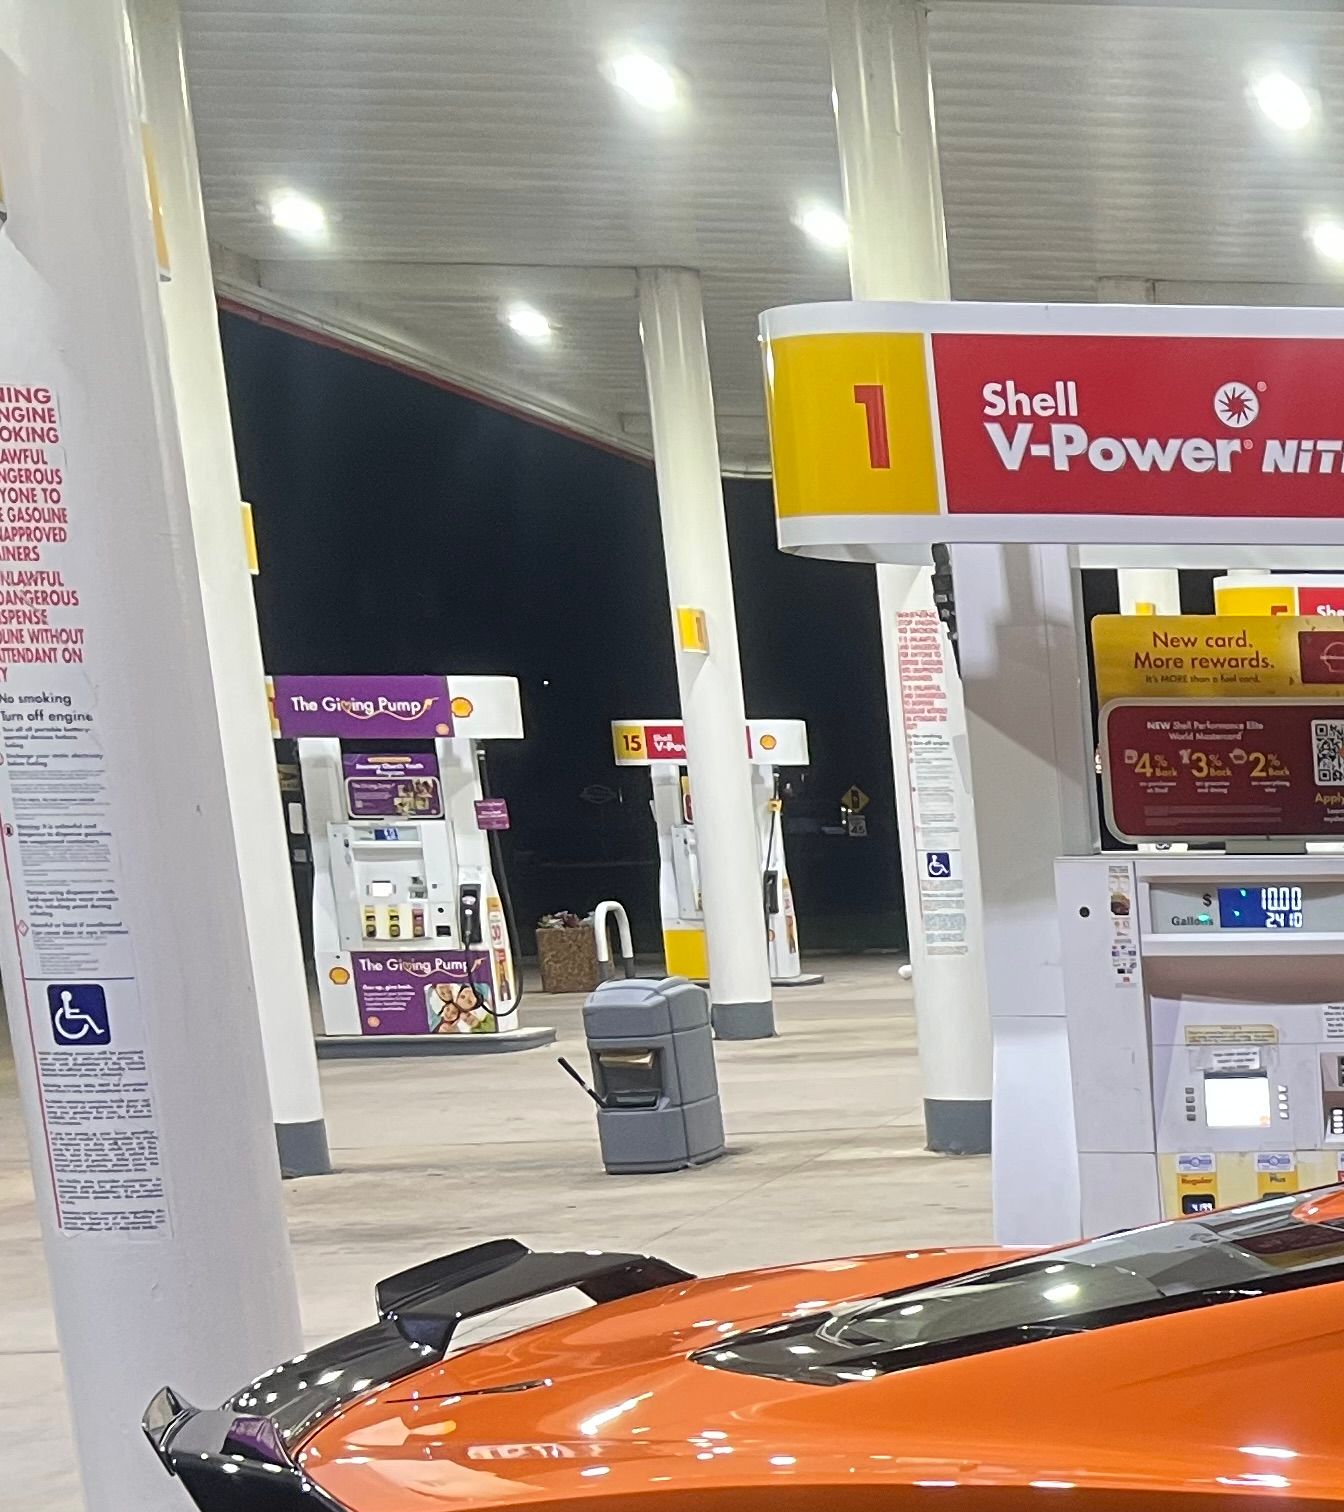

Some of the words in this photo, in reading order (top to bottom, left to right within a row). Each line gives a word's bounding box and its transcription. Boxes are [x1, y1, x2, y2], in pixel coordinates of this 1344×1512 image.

[982, 380, 1078, 417] Shell
[853, 385, 890, 469] 1
[983, 422, 1242, 473] V-Power
[41, 488, 61, 504] TO
[7, 507, 68, 523] GASOLINE
[28, 628, 84, 645] WITHOUT
[1153, 631, 1198, 648] New
[1205, 630, 1253, 648] card.
[62, 648, 82, 663] ON
[1134, 652, 1184, 669] More
[1191, 650, 1274, 669] rewards.
[1161, 675, 1188, 683] MORE
[1190, 674, 1211, 683] than
[19, 691, 71, 706] smoking
[291, 696, 318, 711] The
[378, 696, 421, 715] Pump
[1, 710, 23, 721] Turn
[27, 709, 43, 721] off
[49, 710, 93, 724] engine
[1146, 722, 1170, 730] NEW
[623, 734, 641, 751] 15
[1202, 893, 1212, 908] $
[359, 958, 382, 971] The
